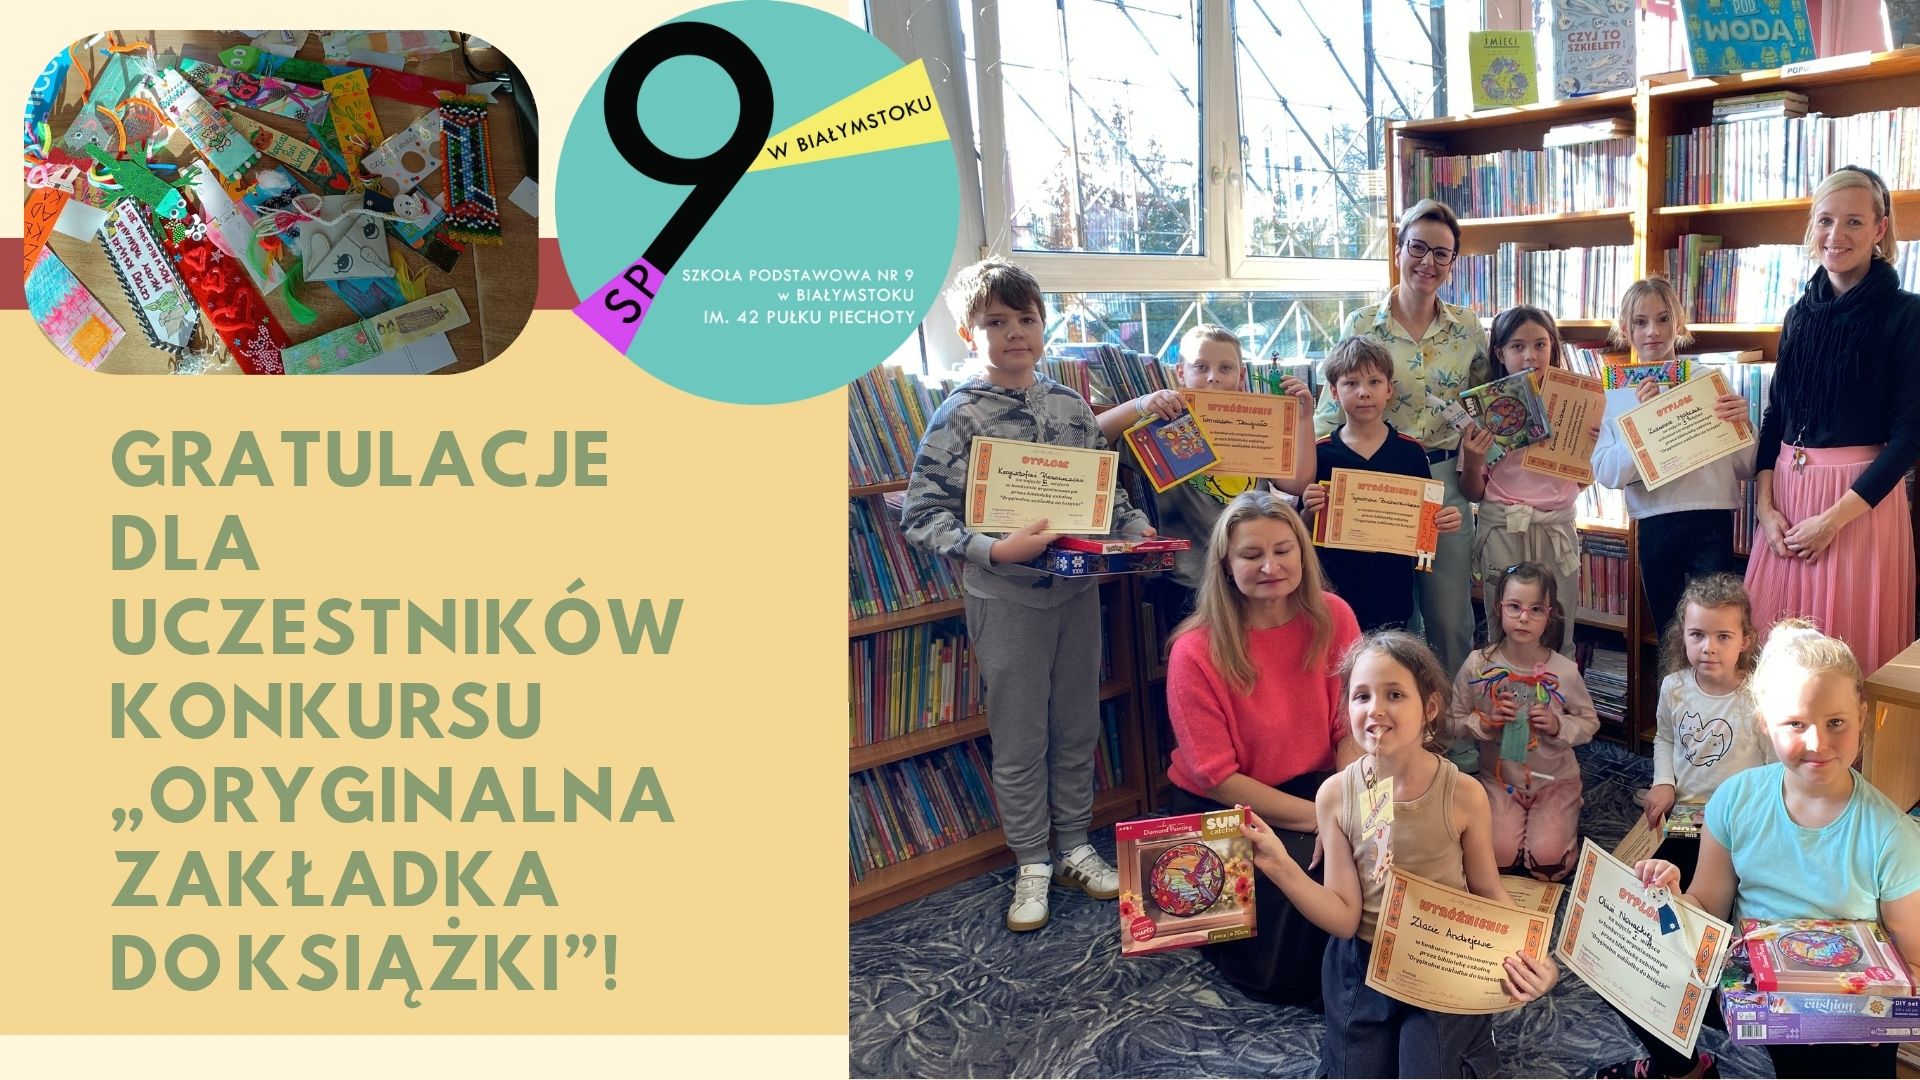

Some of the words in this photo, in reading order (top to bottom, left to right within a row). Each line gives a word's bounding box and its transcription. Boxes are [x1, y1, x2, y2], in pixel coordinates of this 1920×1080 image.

[1733, 0, 1756, 14] POD
[1568, 31, 1598, 42] CZYJ
[1602, 30, 1621, 40] TO
[1704, 19, 1797, 48] WODĄ
[1568, 41, 1621, 52] SZKIELET?
[142, 263, 162, 292] MŁODY
[131, 271, 150, 300] CZYTAJ
[1657, 395, 1693, 417] DYPLOM
[1022, 456, 1070, 468] DYPLOM
[1143, 827, 1169, 836] Diamond
[1169, 824, 1193, 833] Painting
[1206, 815, 1240, 830] SUN
[1420, 899, 1510, 934] WYRÓŻNIENIE
